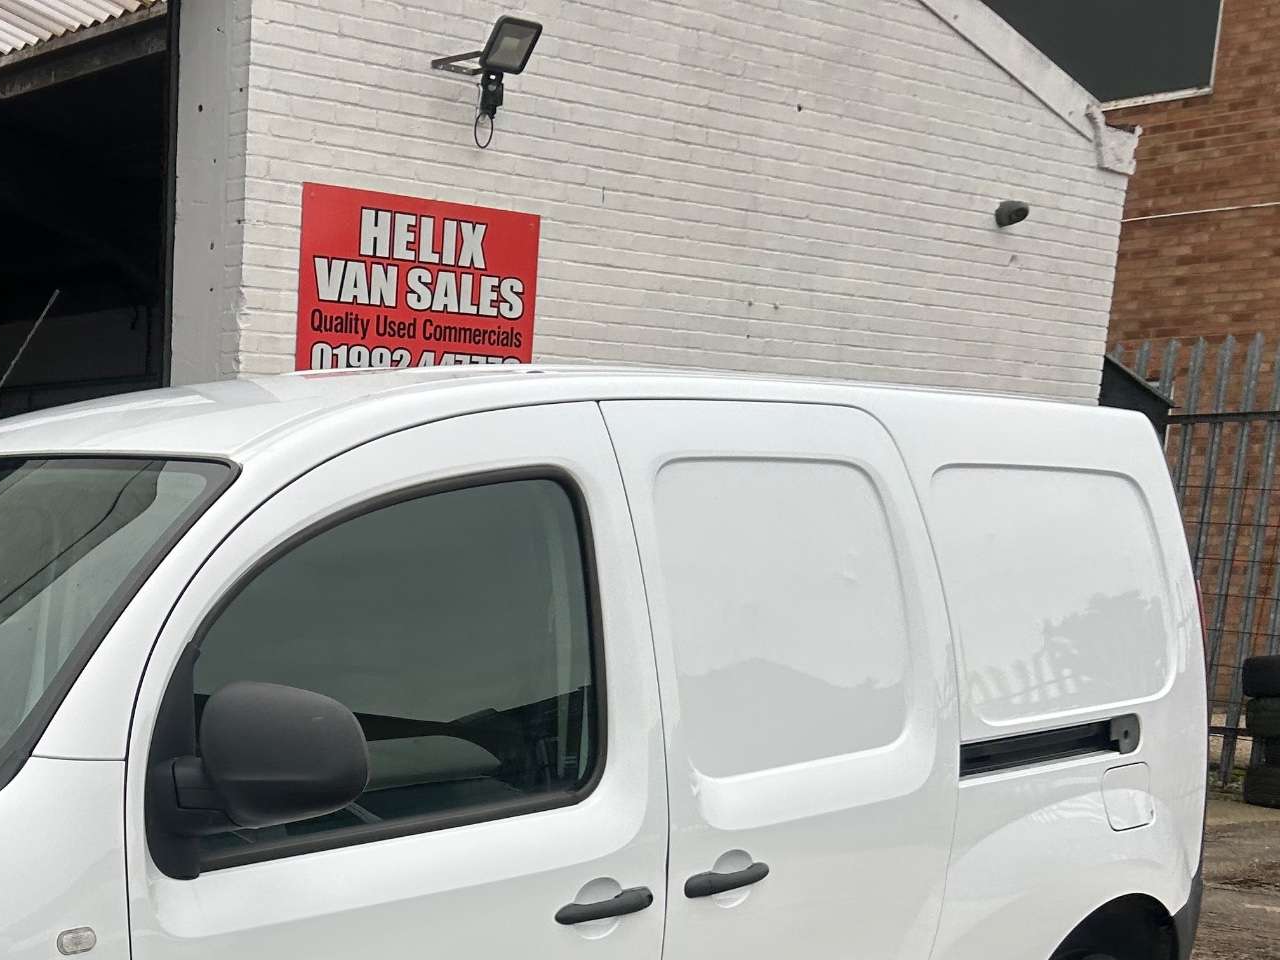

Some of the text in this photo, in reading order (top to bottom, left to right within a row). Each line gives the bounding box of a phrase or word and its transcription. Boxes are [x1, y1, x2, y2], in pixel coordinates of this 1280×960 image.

[359, 206, 487, 271] HELIX
[313, 256, 524, 321] VAN SALES
[311, 309, 522, 348] Quality Used Commercials
